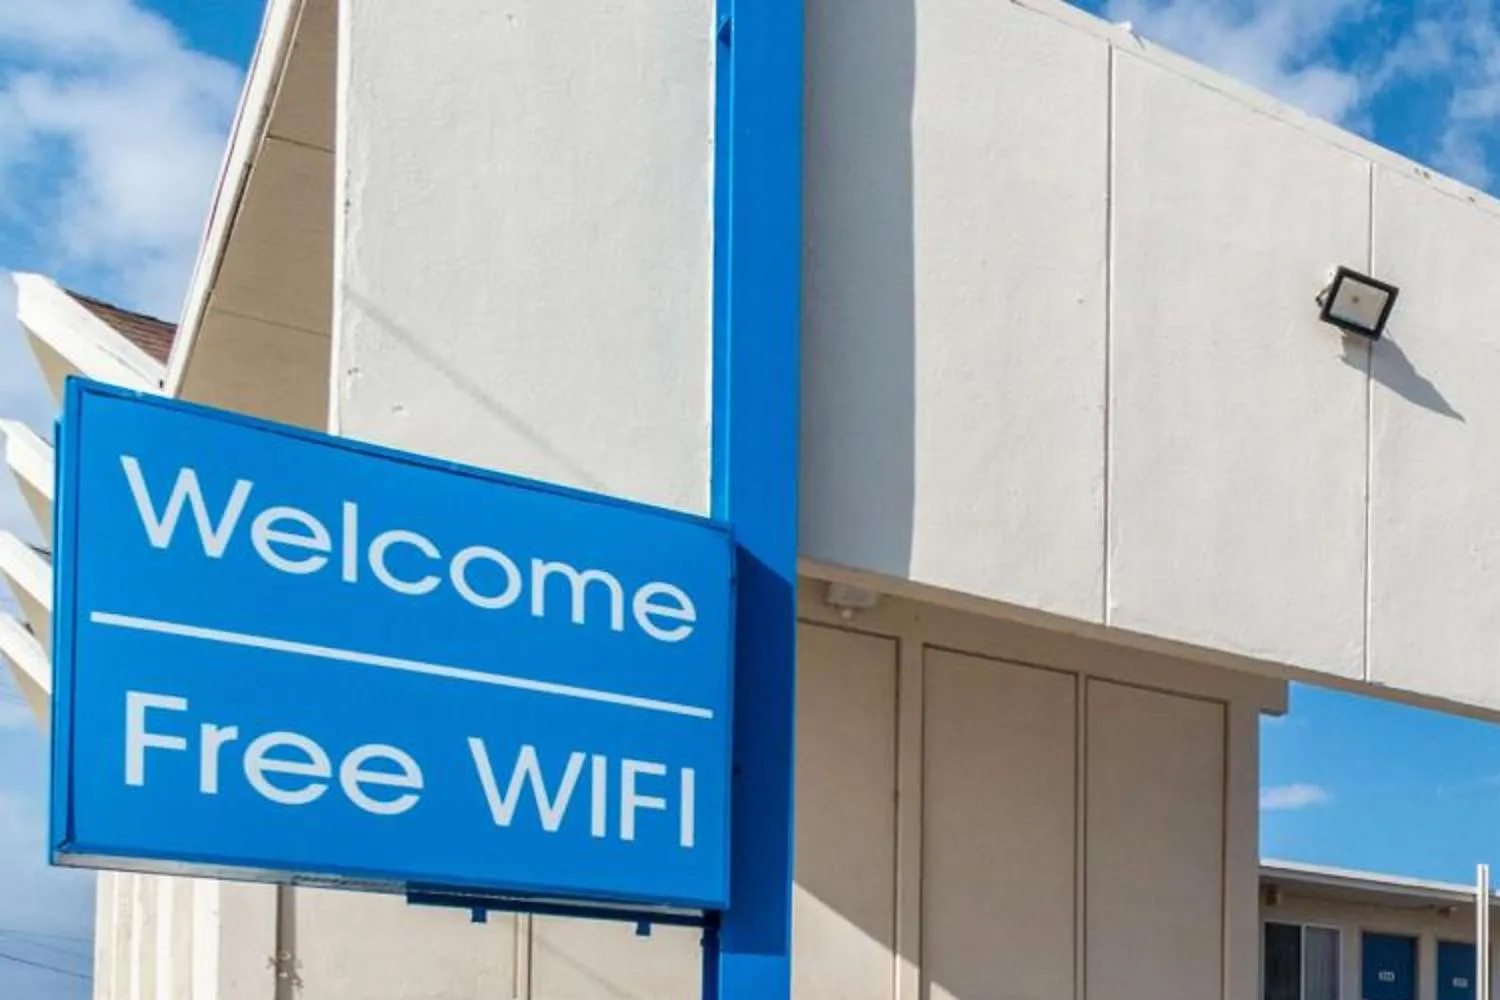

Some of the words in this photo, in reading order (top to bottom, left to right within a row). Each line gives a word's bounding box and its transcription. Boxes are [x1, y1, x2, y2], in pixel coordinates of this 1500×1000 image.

[121, 455, 697, 642] Welcome
[125, 690, 424, 815] Free
[468, 737, 695, 848] WIFI
